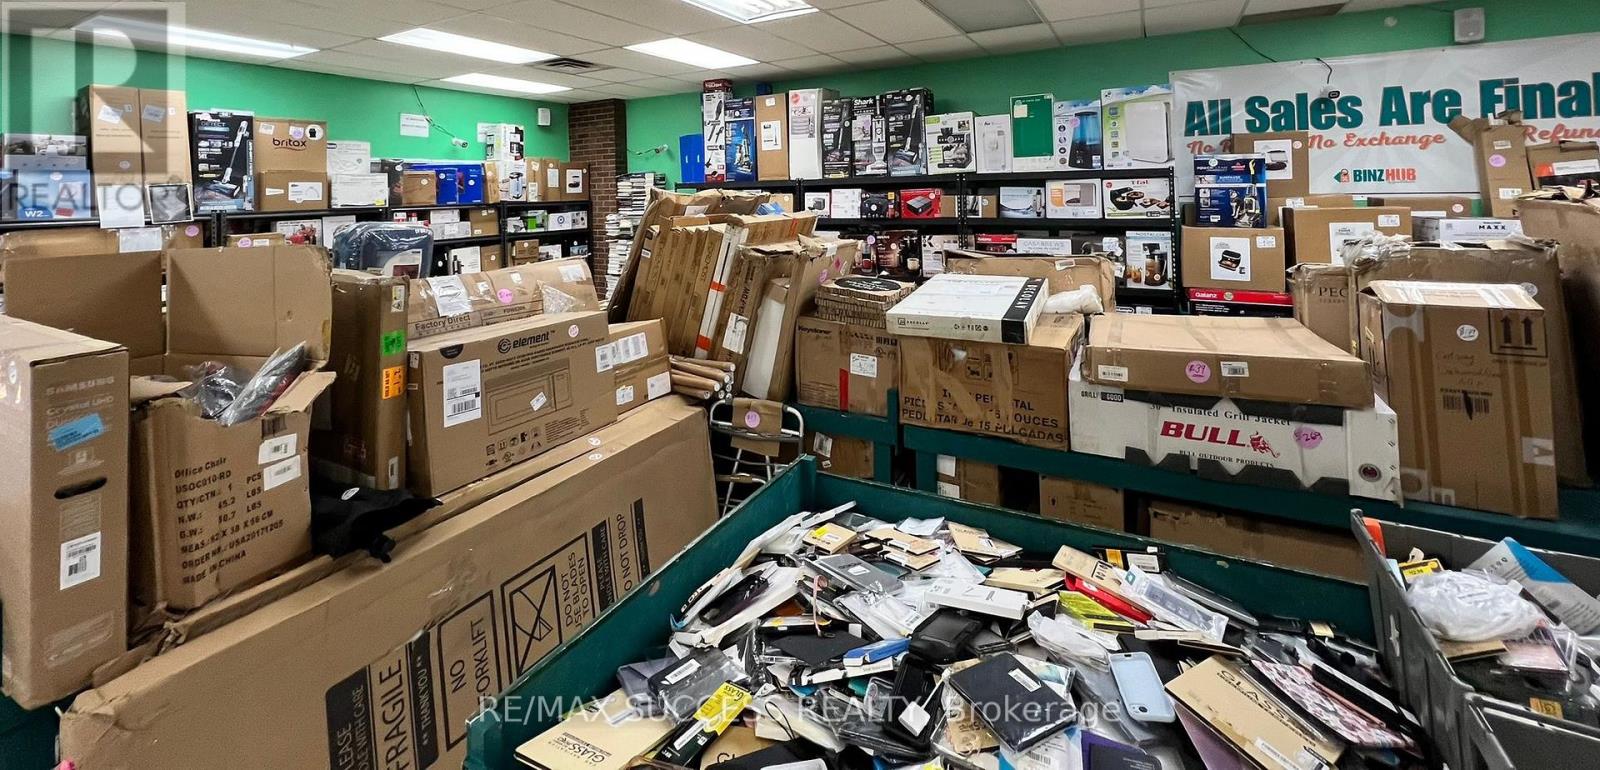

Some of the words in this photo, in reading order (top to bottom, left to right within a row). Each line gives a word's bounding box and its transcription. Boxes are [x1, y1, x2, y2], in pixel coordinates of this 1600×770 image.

[853, 98, 874, 106] Shark
[1184, 98, 1232, 137] All
[1244, 92, 1365, 134] Sales
[1379, 85, 1463, 127] Are
[1309, 133, 1338, 150] No
[1343, 131, 1447, 151] Exchange
[415, 318, 447, 331] Factory
[447, 314, 471, 325] Direct
[512, 331, 550, 349] element
[46, 376, 115, 396] SAMSUNG
[1171, 404, 1220, 419] Insulated
[1224, 410, 1250, 422] Grill
[1255, 415, 1292, 427] Jacket
[1160, 420, 1247, 447] BULL
[174, 466, 203, 480] Office
[204, 457, 227, 471] Chair
[246, 471, 262, 484] PCS
[246, 486, 262, 499] LBS
[246, 501, 263, 513] LBS
[616, 513, 628, 550] DROP
[182, 552, 211, 570] ORDER
[182, 569, 207, 585] MADE
[209, 563, 218, 574] IN
[218, 550, 246, 568] CHINA
[619, 551, 632, 580] NOT
[561, 571, 571, 603] NOT
[568, 552, 580, 604] BLADES
[577, 557, 589, 595] OPEN
[564, 603, 574, 628] DO
[582, 597, 590, 619] TO
[470, 617, 492, 706] FORKLIFT
[417, 667, 429, 694] YOU
[449, 659, 467, 695] NO
[723, 685, 744, 702] GLASS
